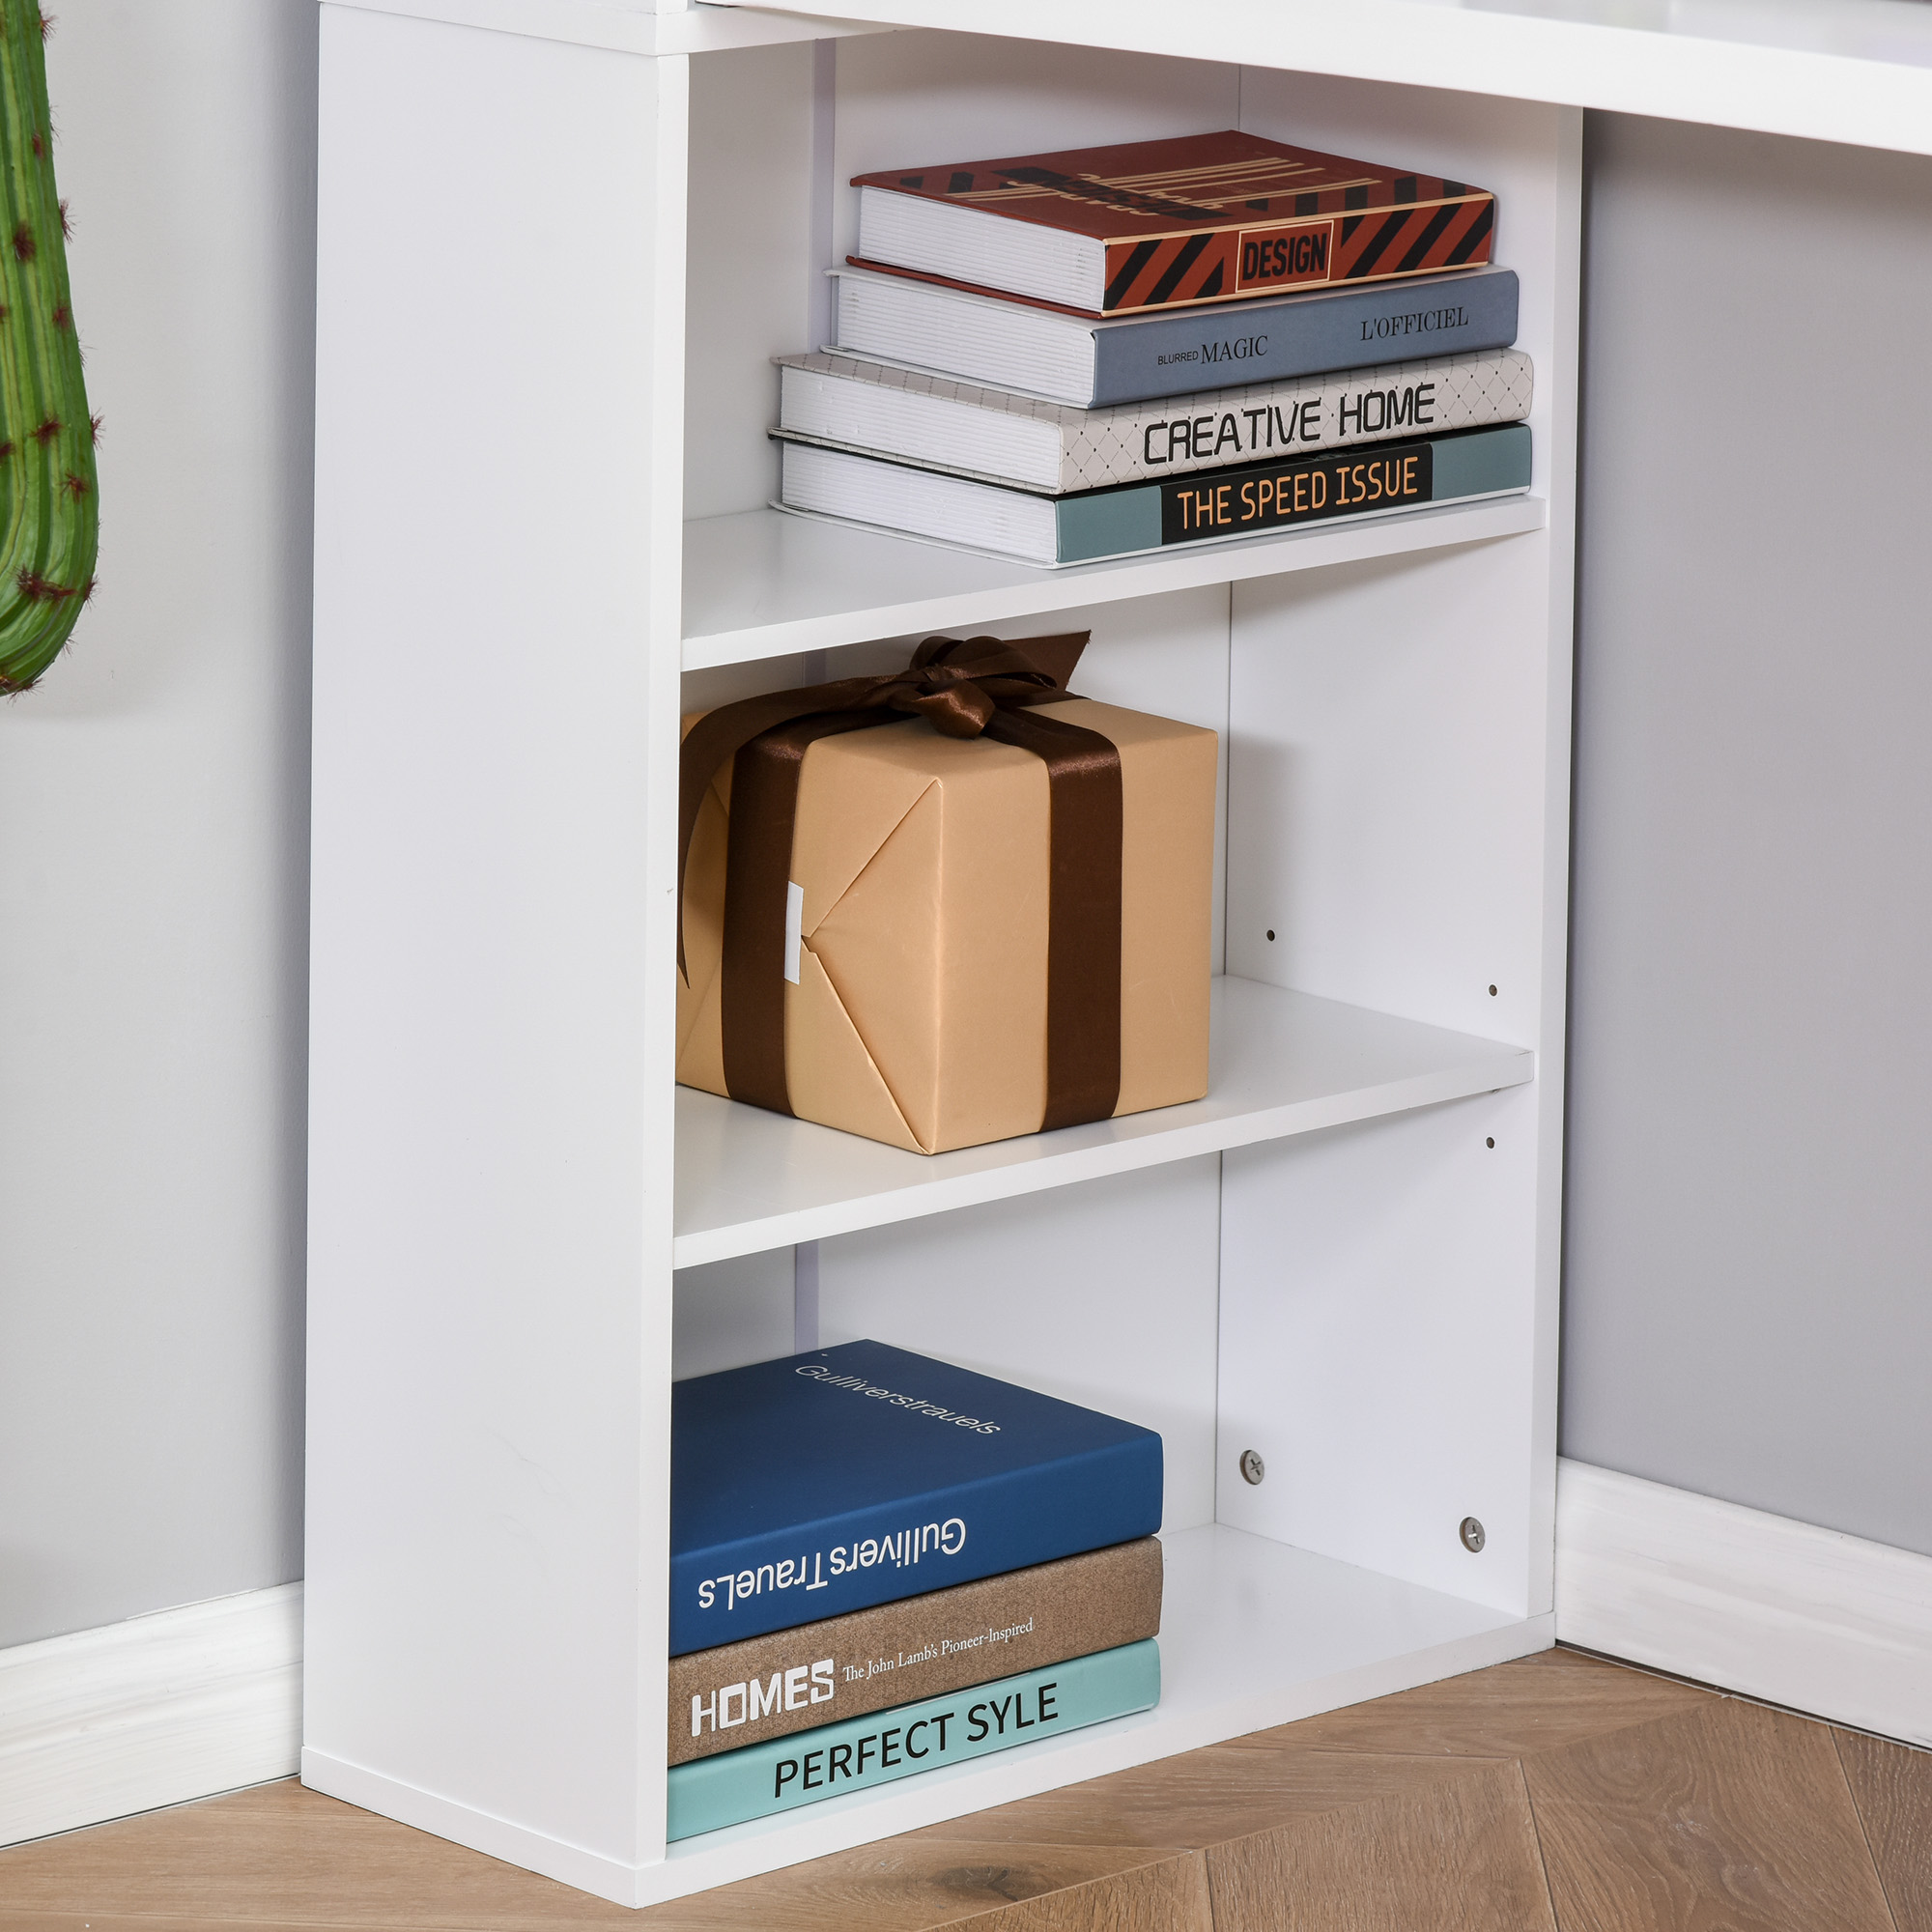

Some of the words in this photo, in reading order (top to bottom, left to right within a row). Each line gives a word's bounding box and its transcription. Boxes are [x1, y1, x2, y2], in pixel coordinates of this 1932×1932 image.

[1241, 232, 1328, 281] DESIGN
[1157, 350, 1199, 366] BLURRED
[1201, 334, 1269, 365] MAGIC
[1359, 305, 1469, 342] L'OFFICIEL
[1144, 397, 1323, 466] CREATIVE
[1339, 383, 1435, 438] HOME
[1177, 485, 1232, 530] THE
[1240, 470, 1327, 522] SPEED
[1335, 456, 1419, 506] ISSUE
[691, 1658, 835, 1737] HOMES
[842, 1664, 865, 1683] The
[866, 1658, 895, 1681] John
[897, 1643, 939, 1668] Lamb's
[941, 1616, 1034, 1657] Pioneer-Inspired
[774, 1712, 955, 1800] PERFECT
[965, 1682, 1060, 1743] SYLE
